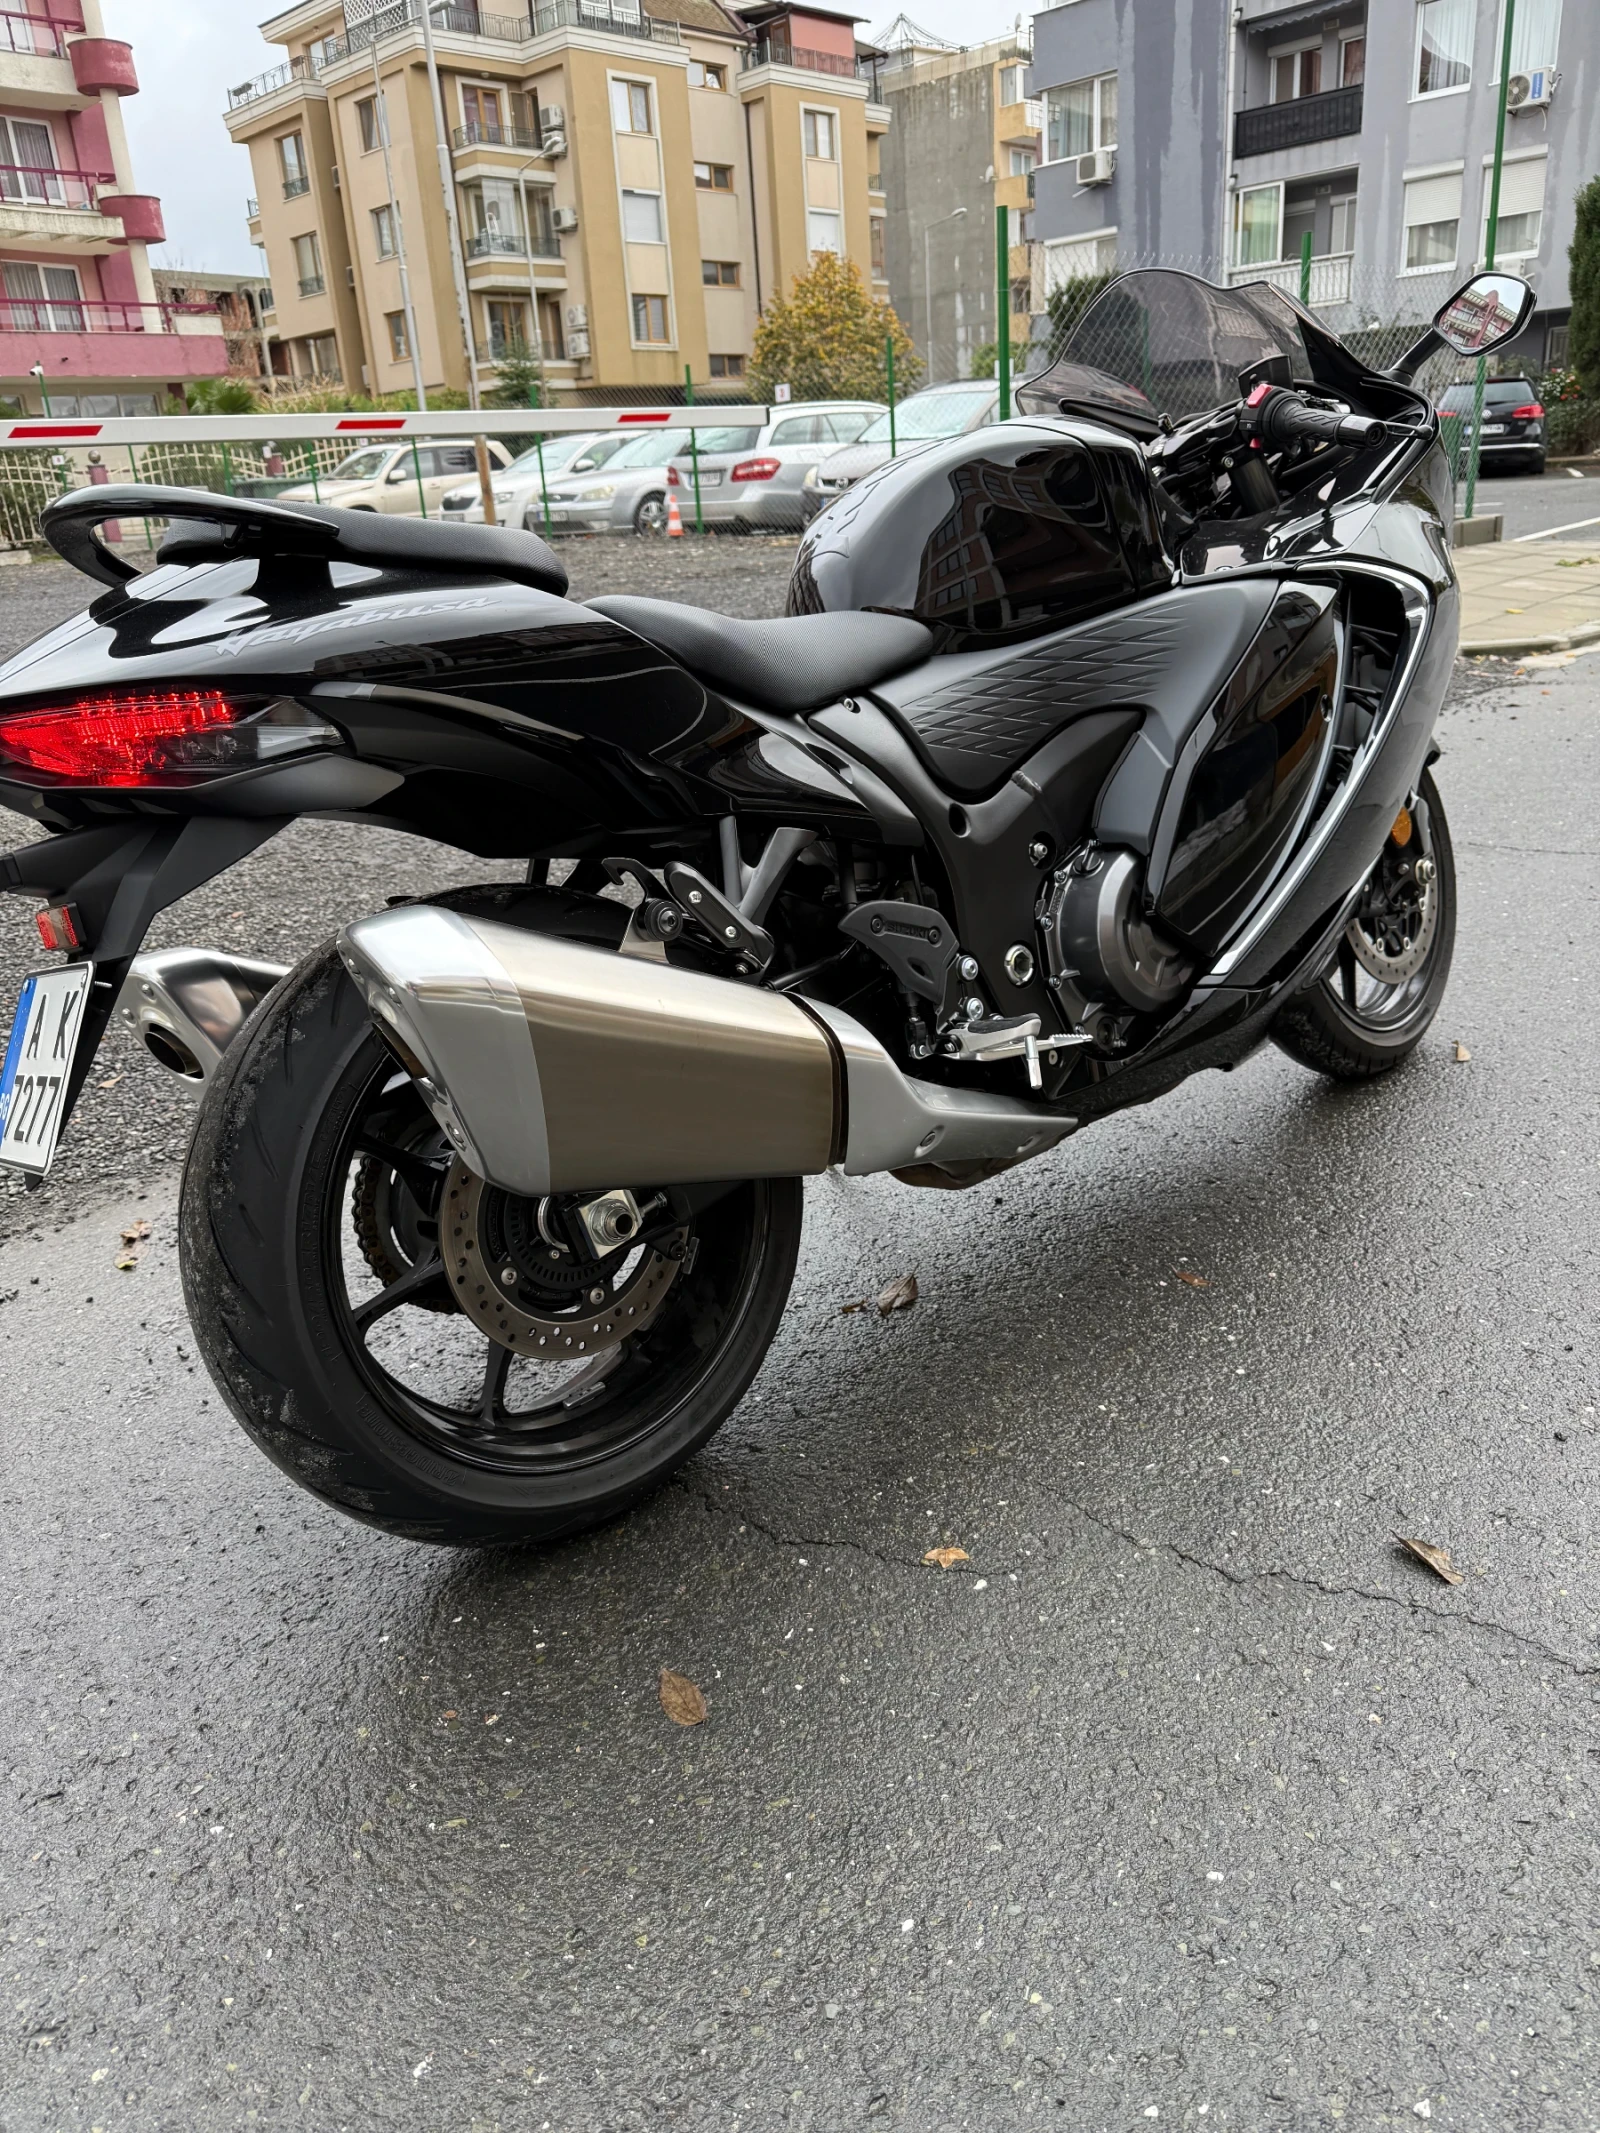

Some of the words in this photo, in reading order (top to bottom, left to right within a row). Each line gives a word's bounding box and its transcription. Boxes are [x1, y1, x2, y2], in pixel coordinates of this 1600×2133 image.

[205, 597, 502, 657] Hayabusa
[886, 921, 928, 939] SUZUKI
[26, 994, 47, 1059] A
[53, 990, 79, 1059] K
[4, 1075, 61, 1144] 7277
[356, 1404, 460, 1486] BRIDGESTONE
